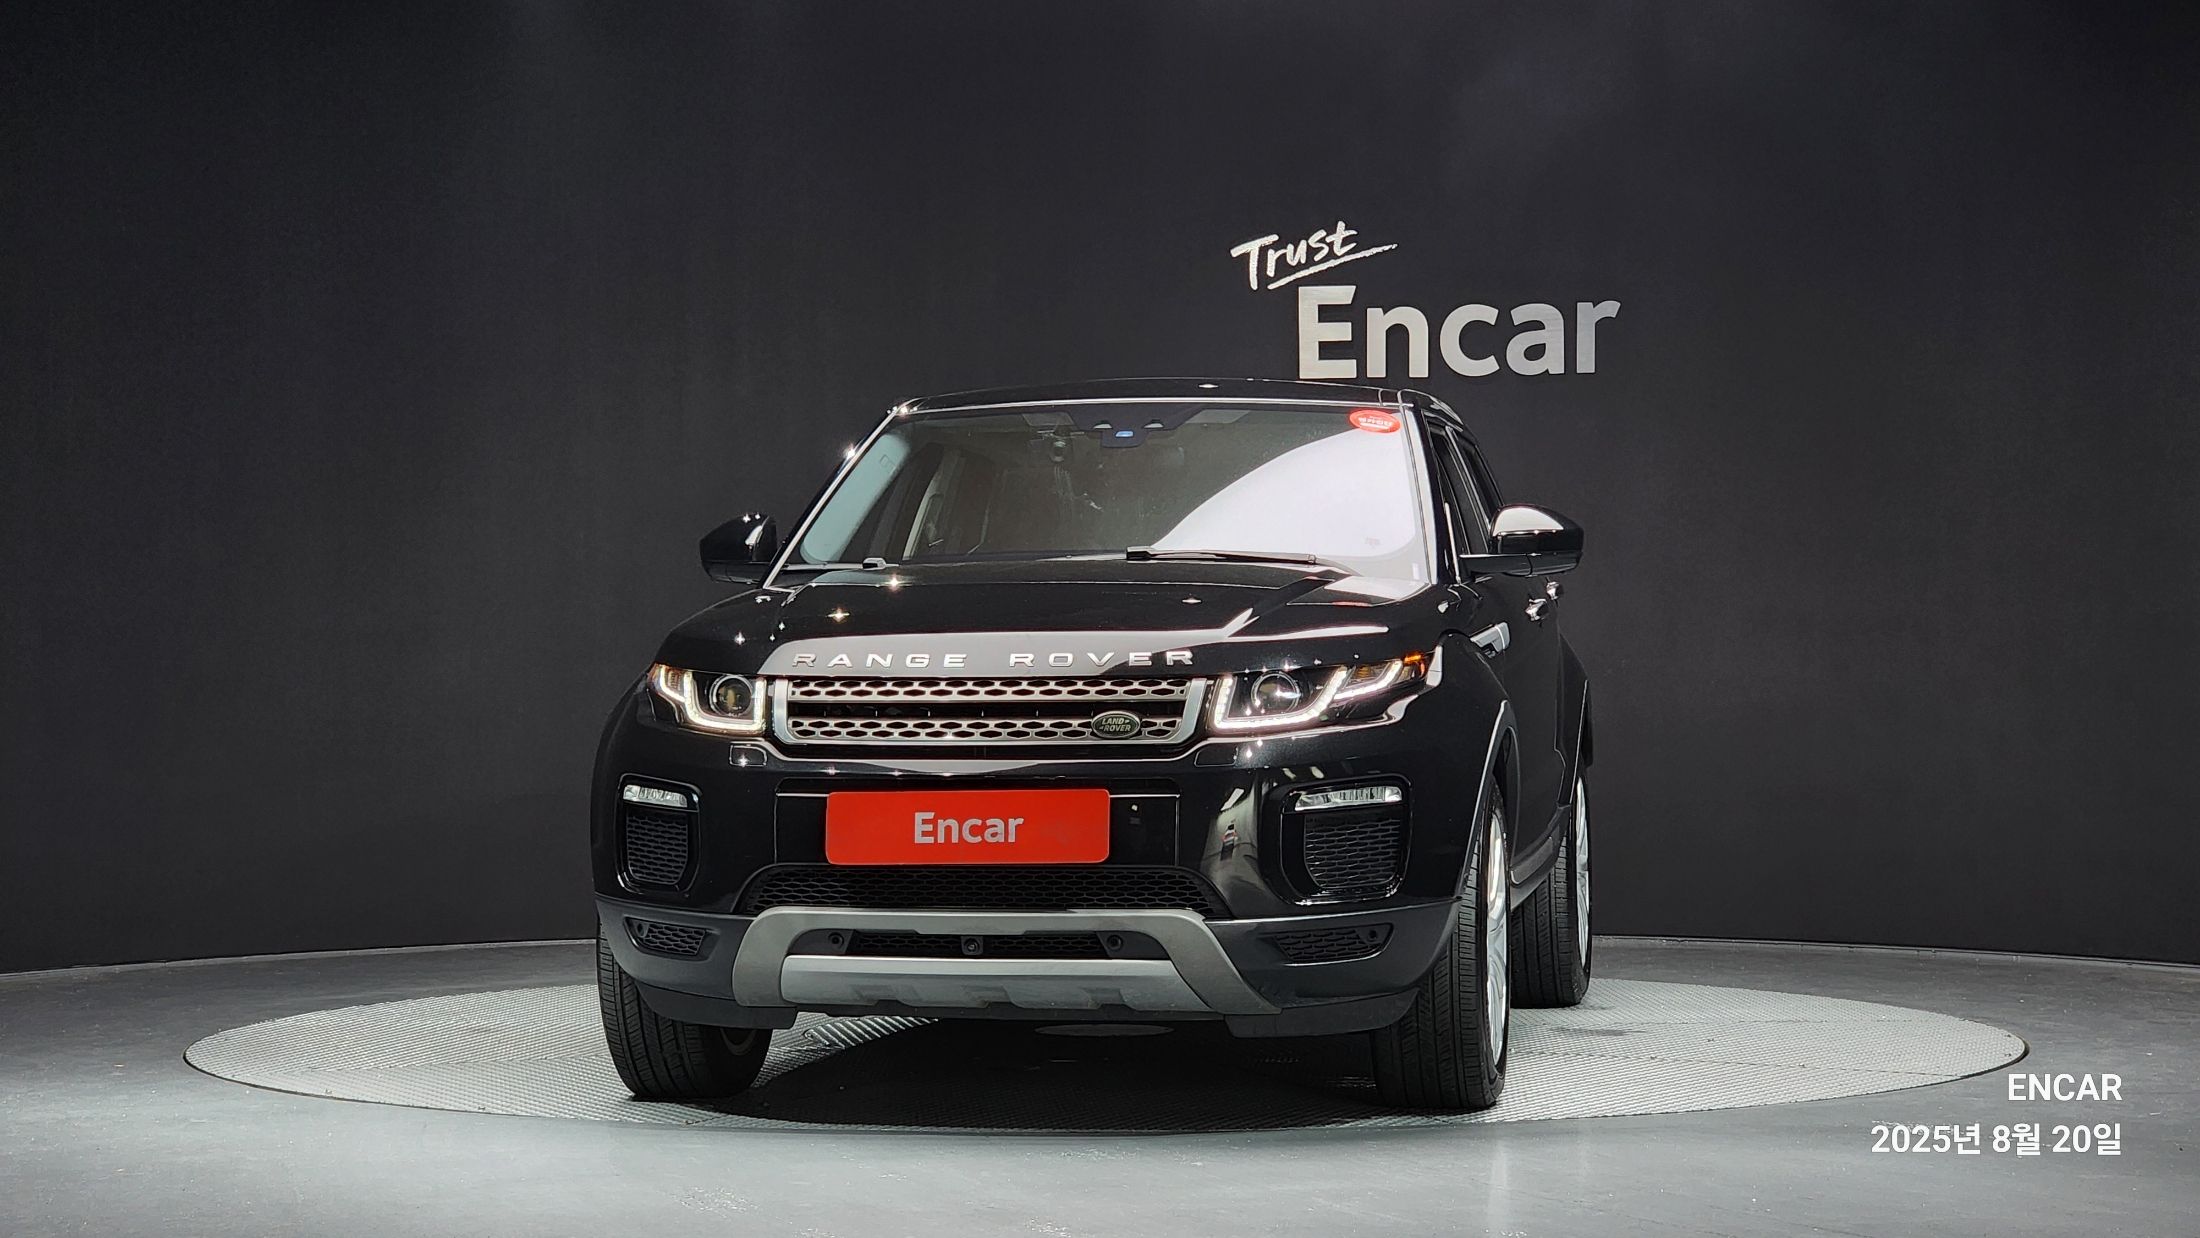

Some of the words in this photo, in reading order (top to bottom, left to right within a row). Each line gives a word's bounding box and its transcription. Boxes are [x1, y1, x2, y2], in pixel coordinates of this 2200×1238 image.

[1230, 220, 1358, 290] Trust
[1298, 285, 1622, 380] Encar
[791, 652, 968, 669] RANGE
[1008, 650, 1194, 668] ROVER
[1101, 717, 1125, 725] LAND
[1103, 724, 1131, 732] ROVER
[913, 811, 1025, 844] Encar
